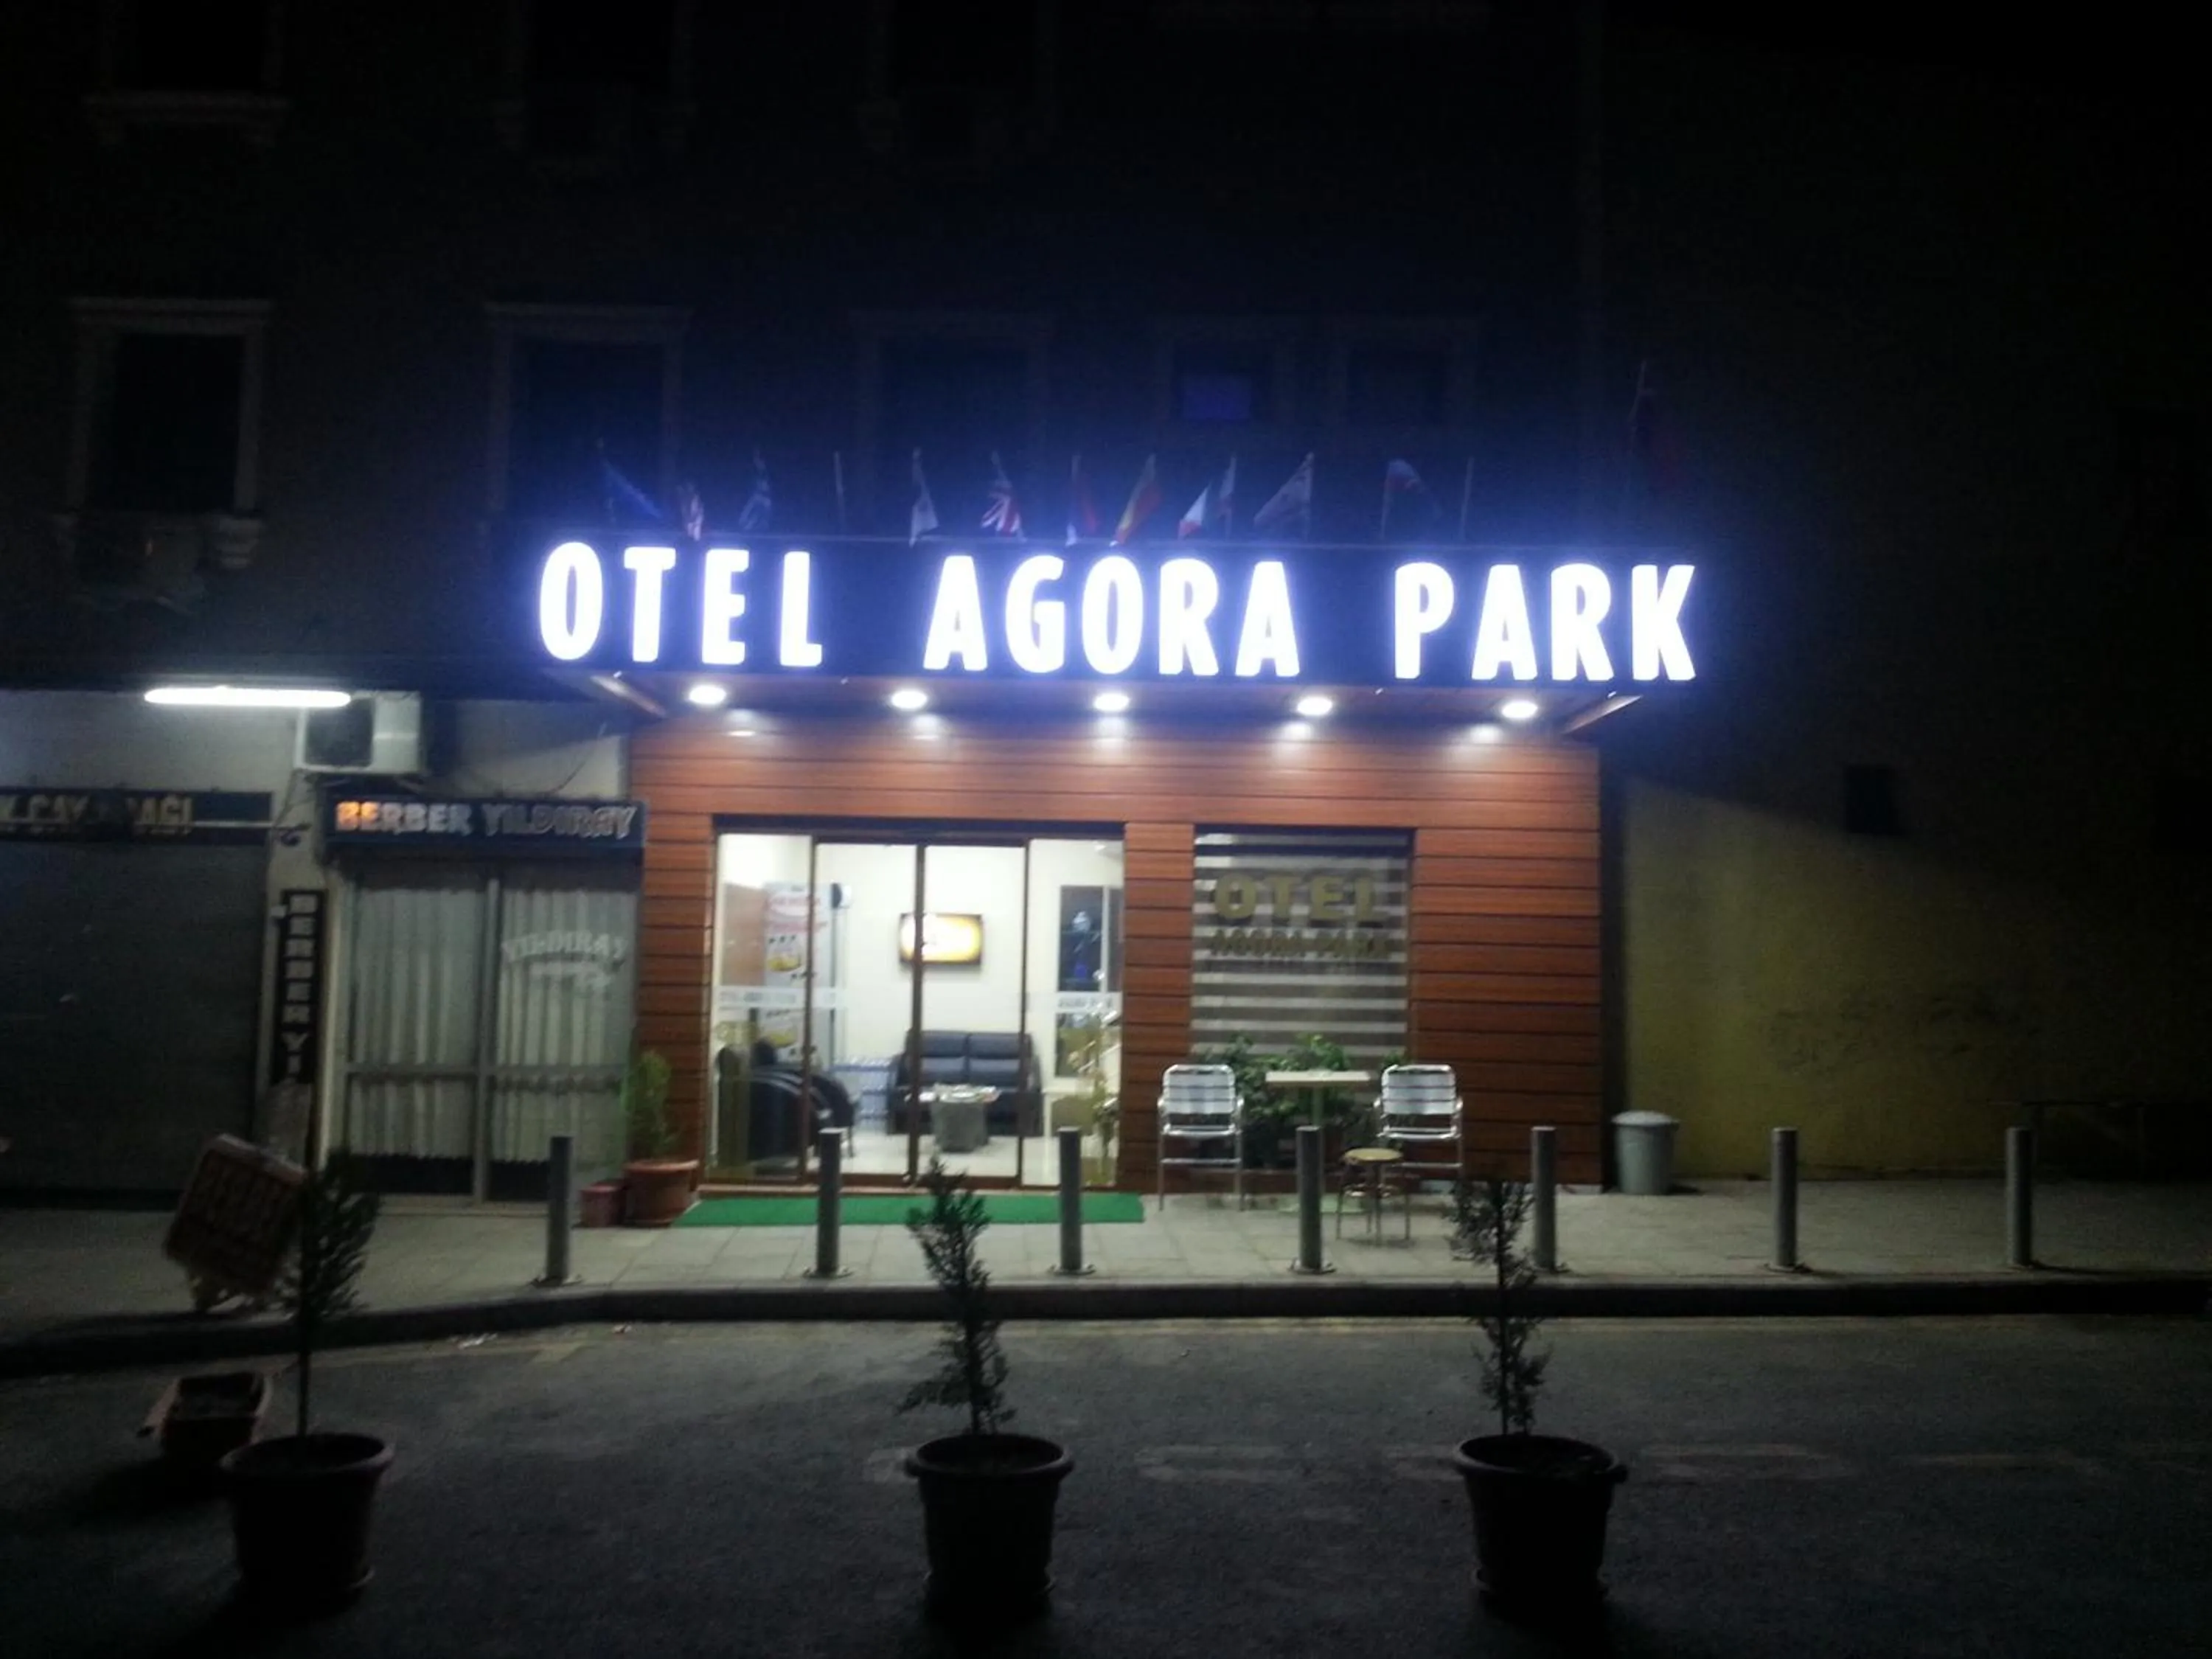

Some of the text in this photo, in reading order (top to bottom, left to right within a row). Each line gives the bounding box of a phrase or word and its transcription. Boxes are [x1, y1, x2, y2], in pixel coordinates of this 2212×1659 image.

[538, 542, 1696, 681] OTEL AGORA PARK
[335, 801, 473, 835] BERBER
[1214, 872, 1390, 922] OTEL
